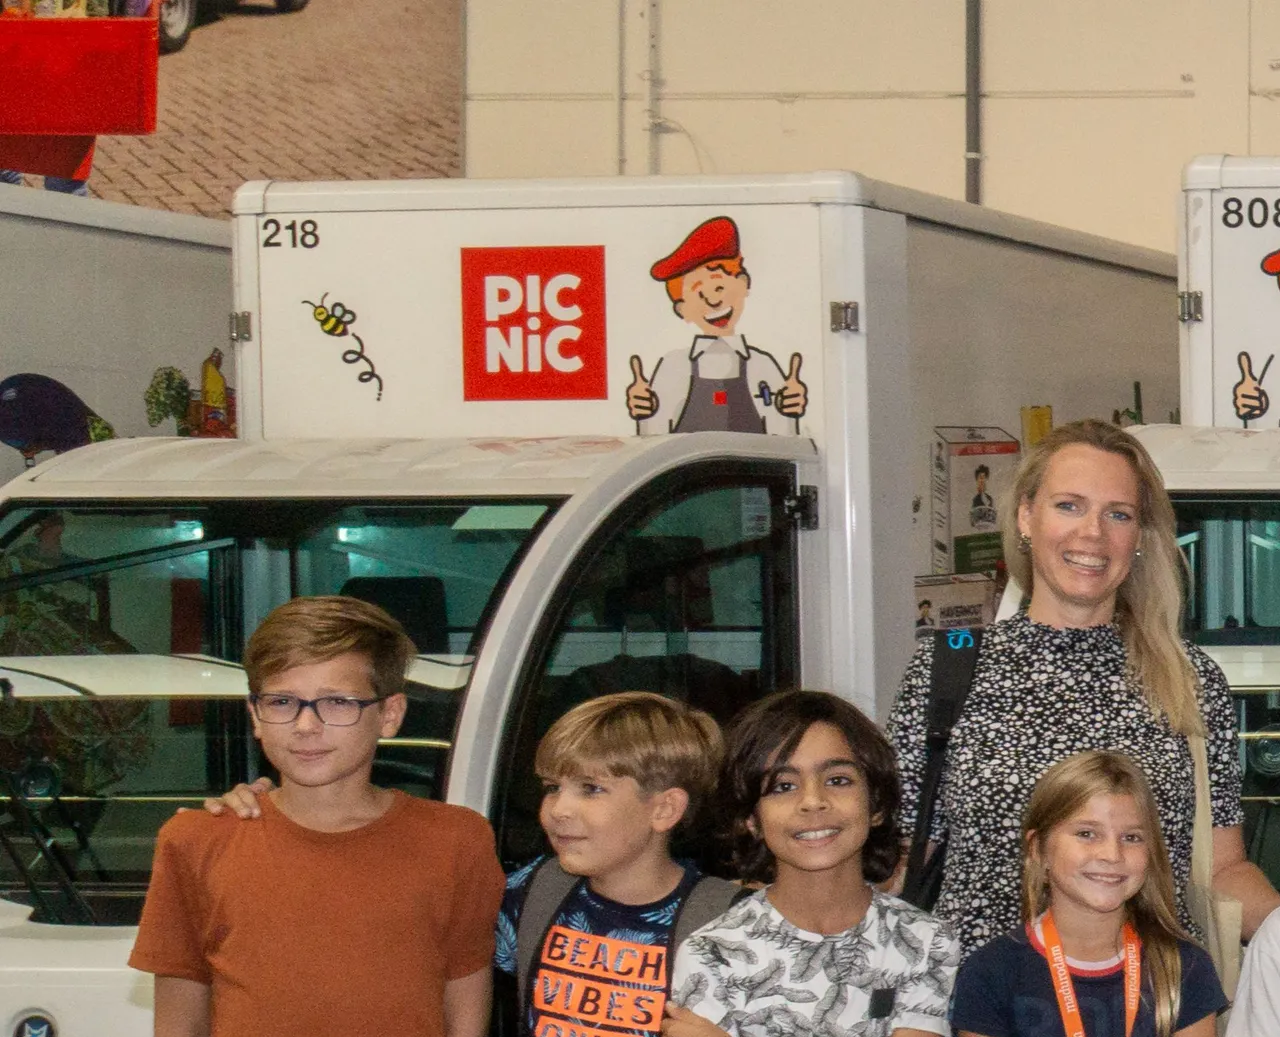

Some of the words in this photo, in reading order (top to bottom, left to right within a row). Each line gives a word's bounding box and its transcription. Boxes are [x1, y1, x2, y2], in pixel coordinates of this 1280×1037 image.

[262, 219, 320, 249] 218
[485, 274, 584, 321] PIC
[547, 931, 664, 981] BEACH
[1051, 945, 1076, 1013] madurodam
[543, 975, 656, 1025] VIBES
